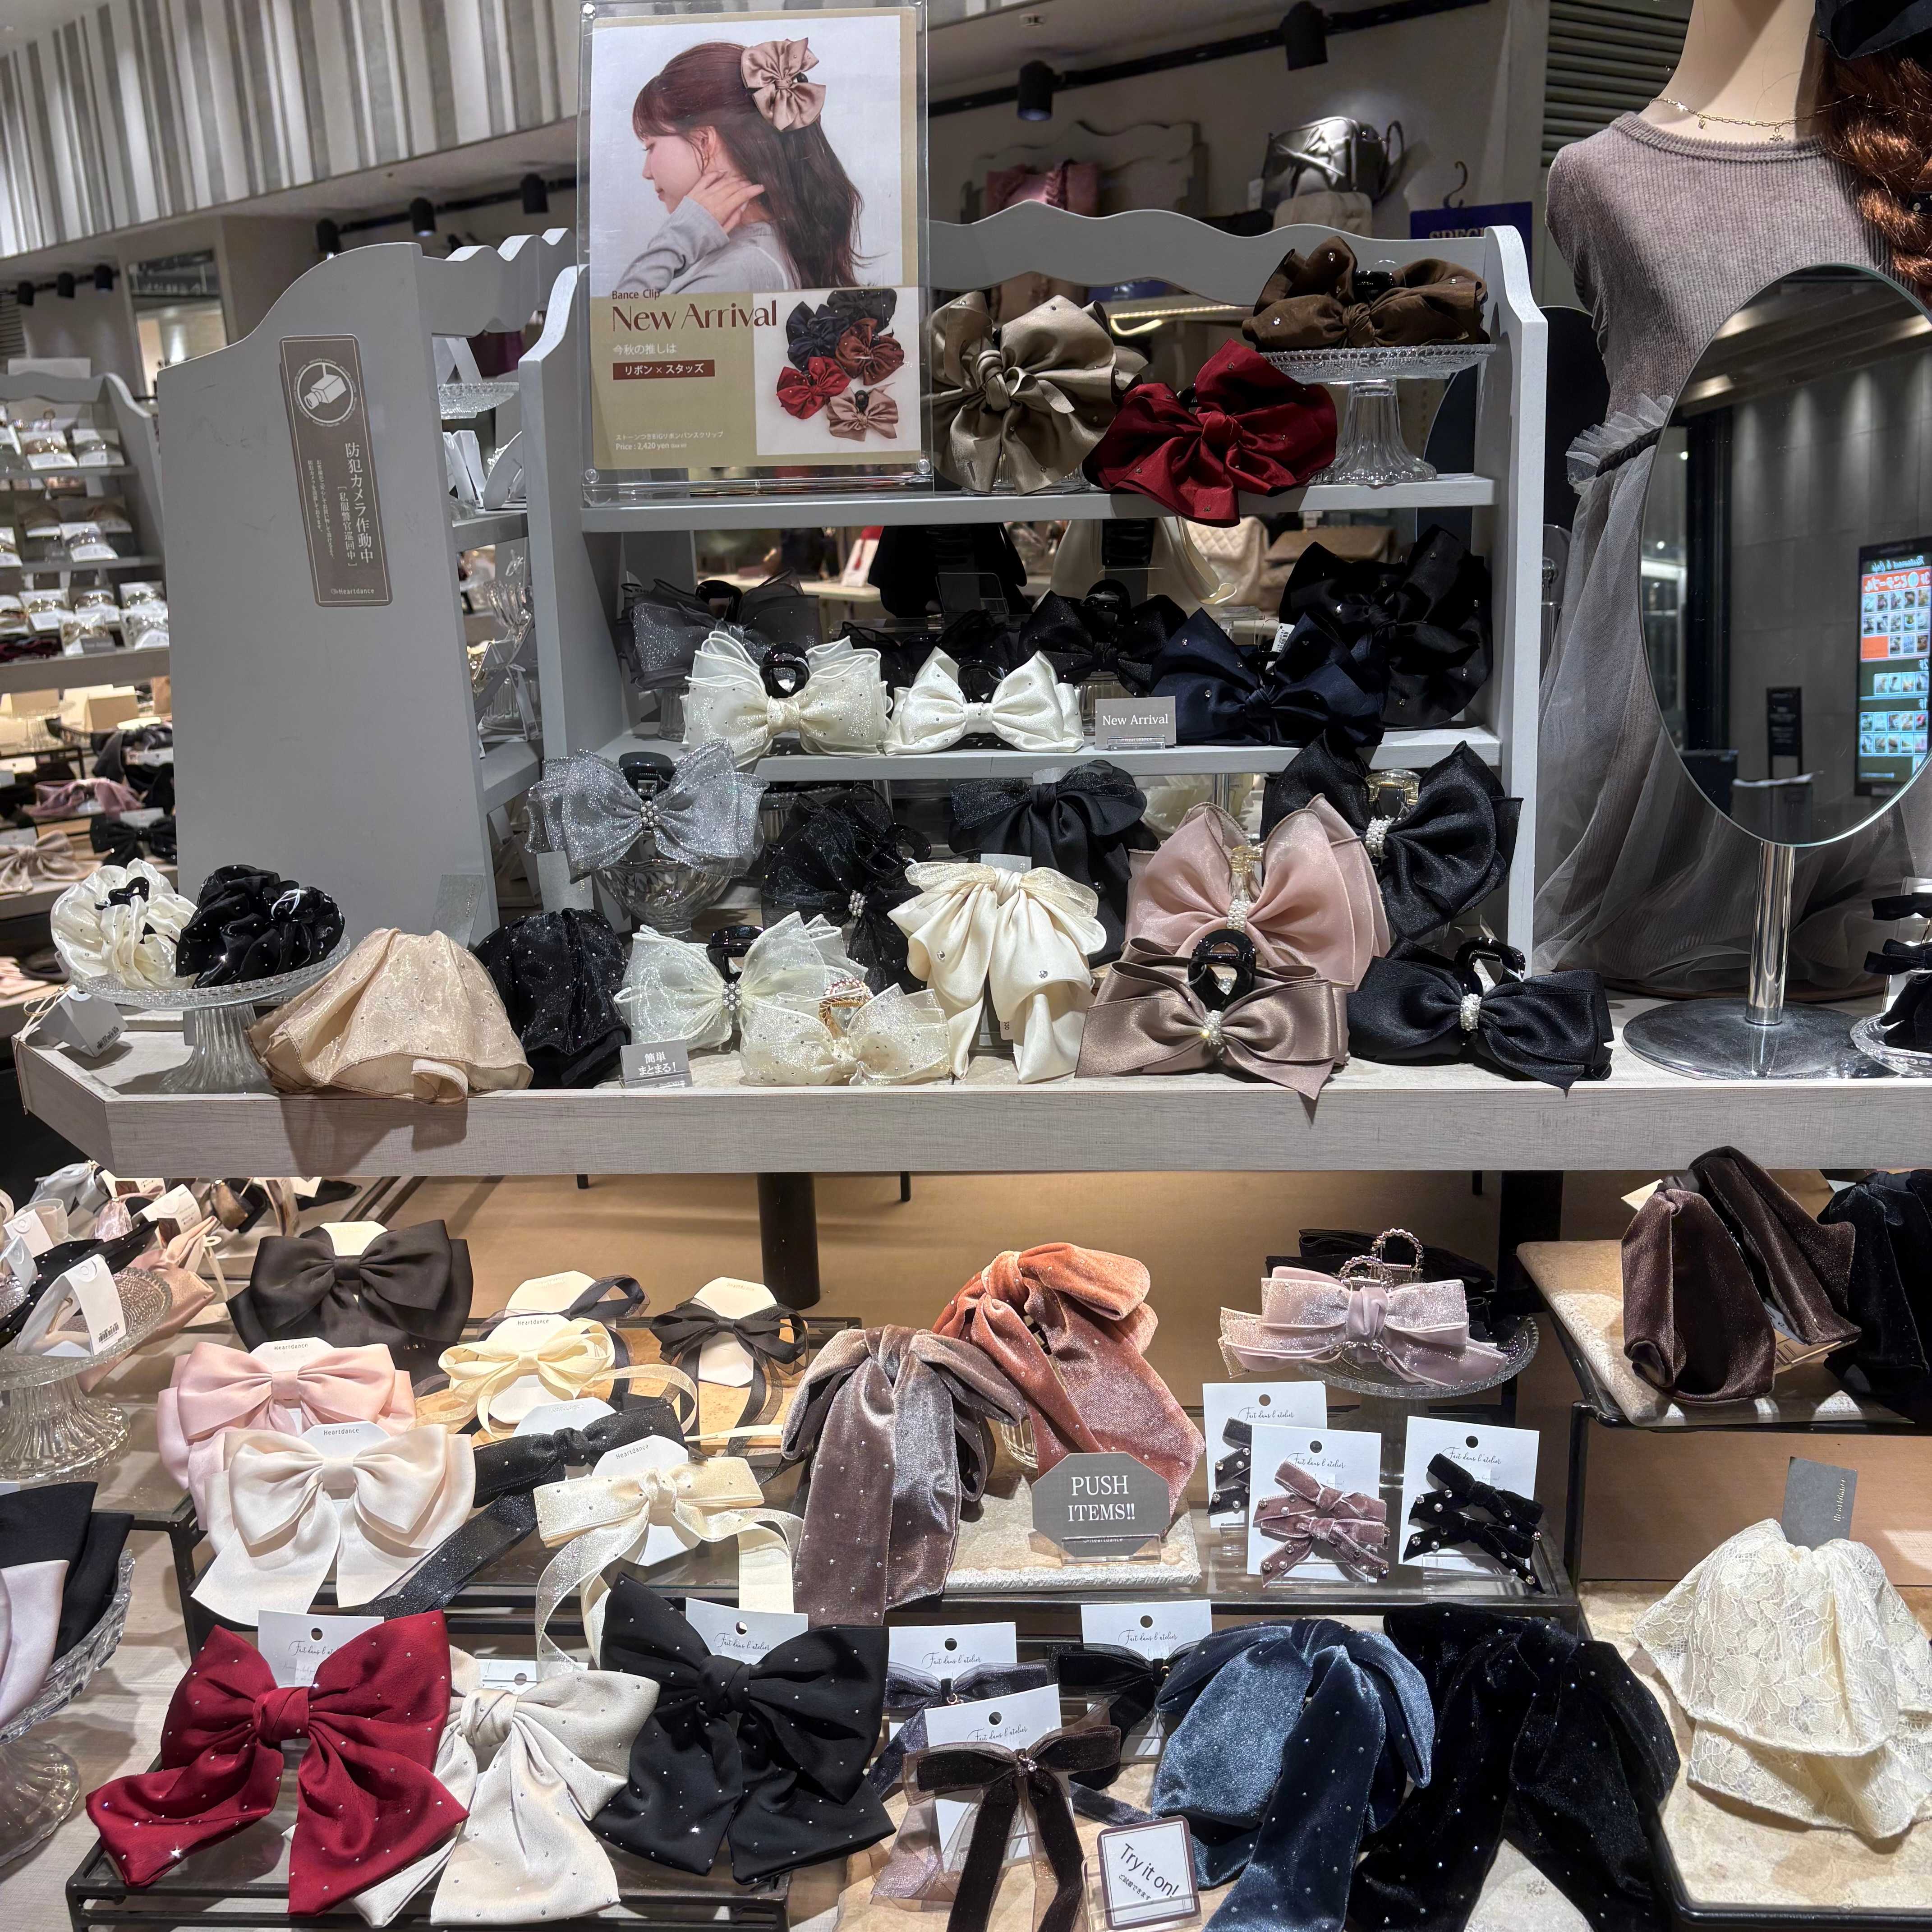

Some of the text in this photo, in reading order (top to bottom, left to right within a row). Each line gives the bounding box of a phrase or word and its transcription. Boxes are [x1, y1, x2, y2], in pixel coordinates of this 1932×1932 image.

[612, 289, 660, 300] Bance Clip
[612, 299, 777, 331] New Arrival
[613, 343, 677, 355] 今秋の推しは
[625, 365, 653, 375] リボン
[666, 363, 704, 374] スタッズ
[638, 442, 656, 451] 2,420
[345, 442, 374, 563] 防犯カメラ作動中
[1103, 714, 1168, 726] New Arrival
[645, 1051, 666, 1064] 簡単
[615, 1444, 649, 1460] Heartdance
[1071, 1475, 1129, 1496] PUSH
[1068, 1503, 1136, 1522] ITEMS!!
[1120, 1843, 1179, 1898] Try it on!
